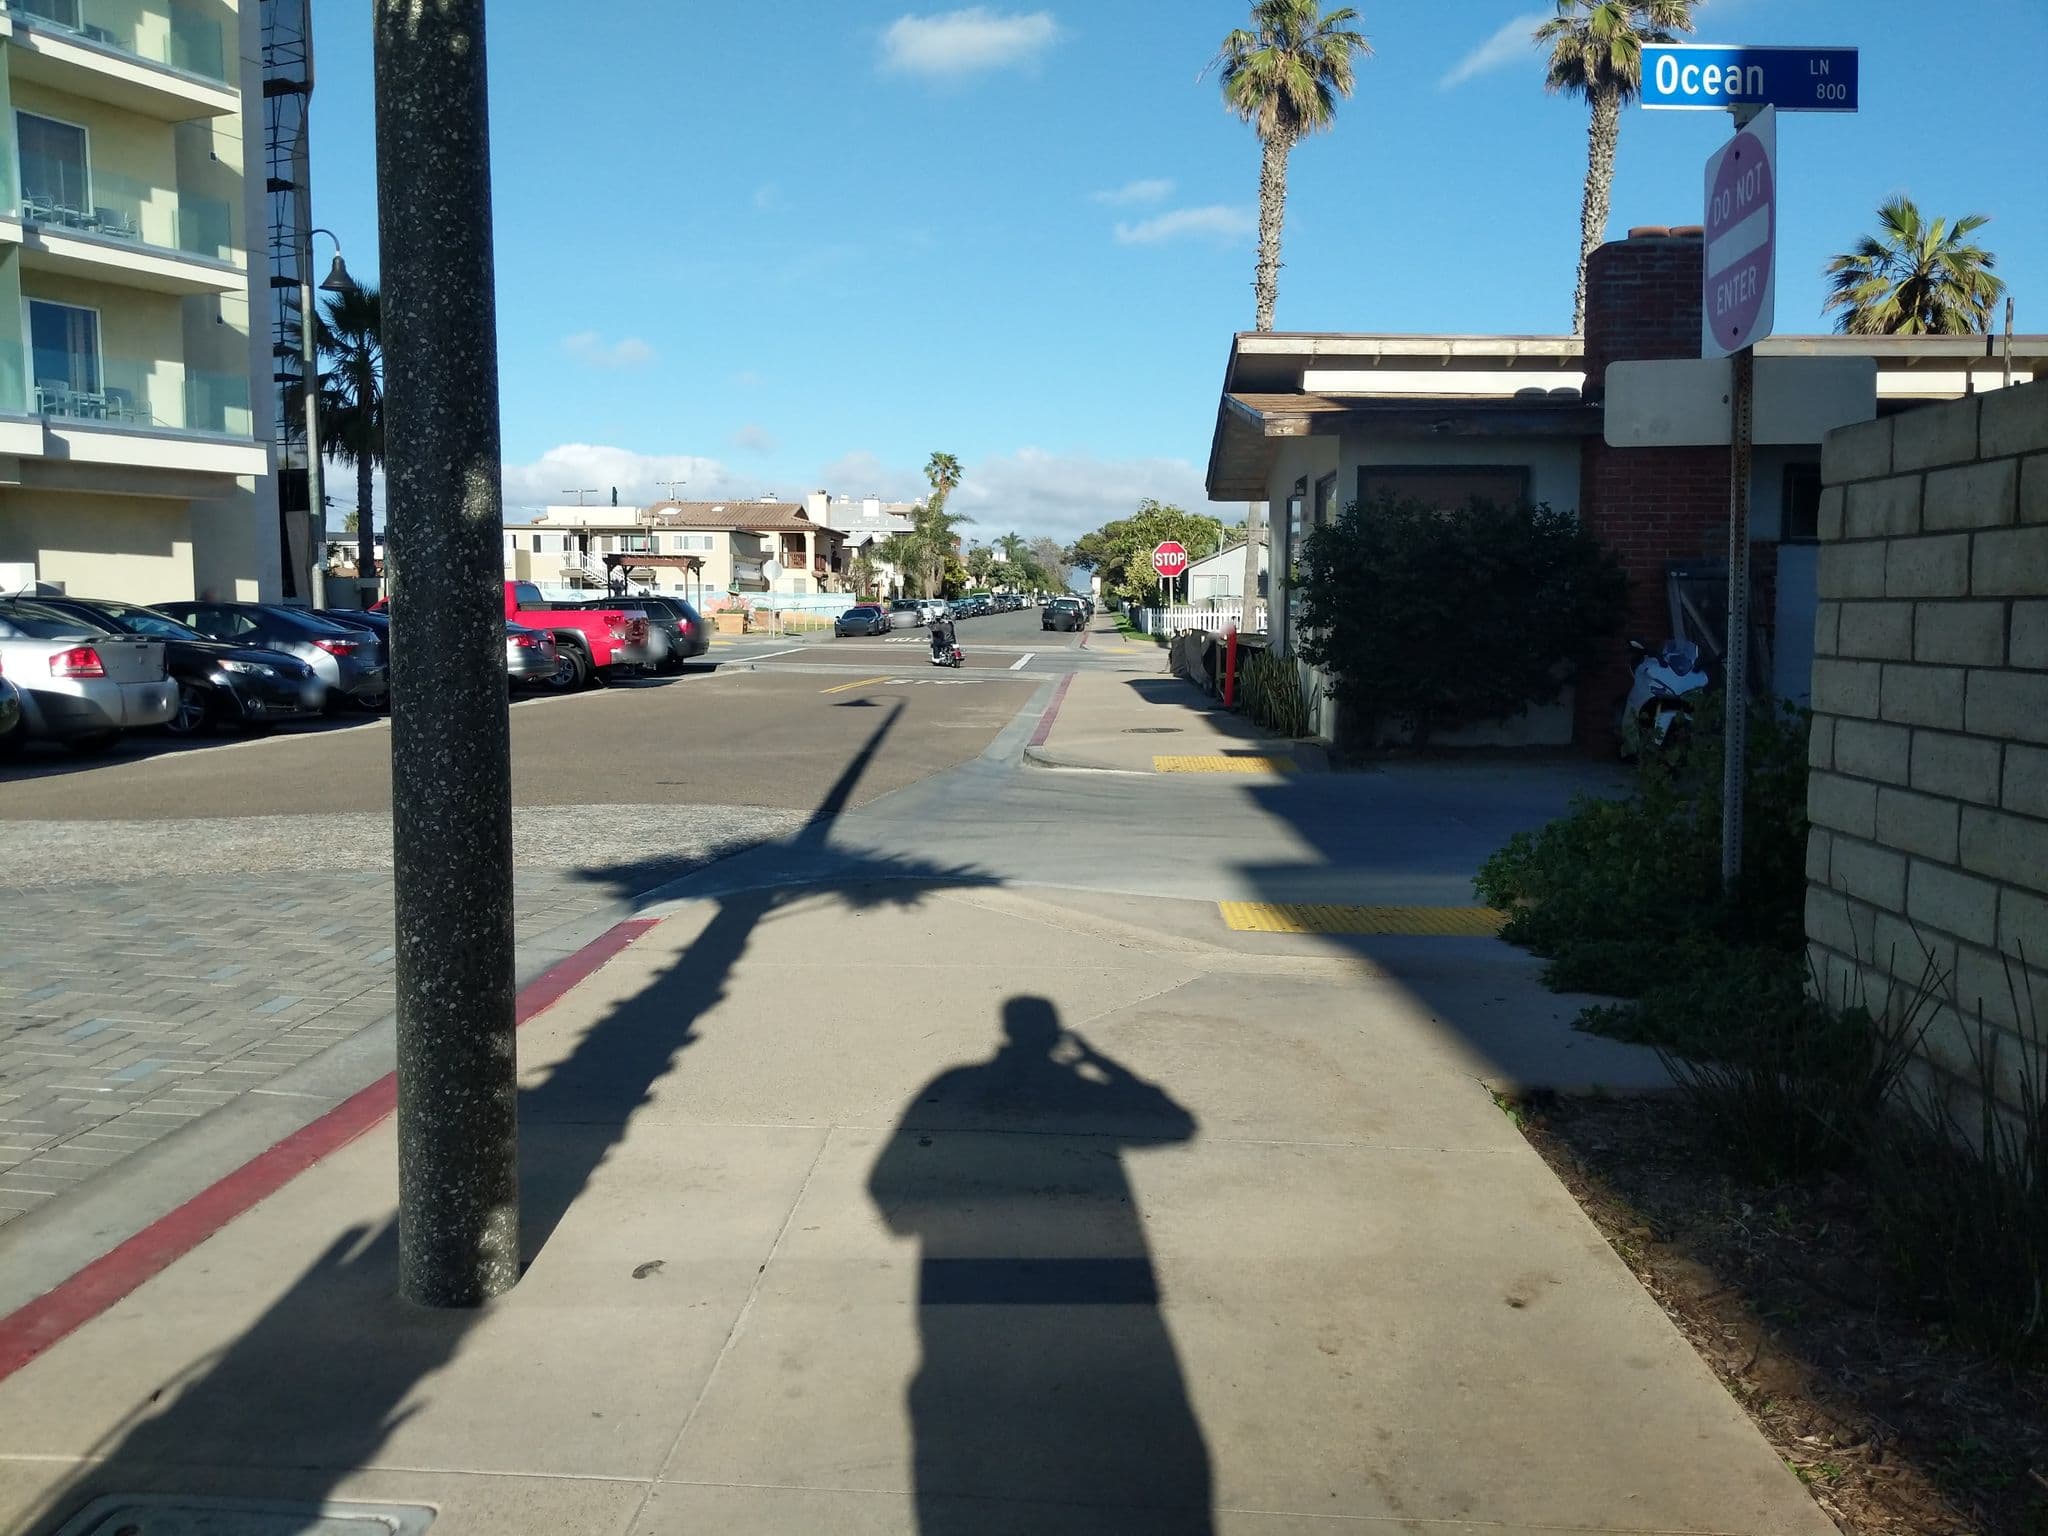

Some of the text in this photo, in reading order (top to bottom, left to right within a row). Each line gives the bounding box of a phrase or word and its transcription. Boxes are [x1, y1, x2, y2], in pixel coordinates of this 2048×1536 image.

[1655, 54, 1829, 95] Ocean LN
[1816, 84, 1846, 100] 800
[1713, 161, 1762, 226] DO NOT
[1717, 265, 1757, 316] ENTER
[1155, 552, 1185, 567] STOP
